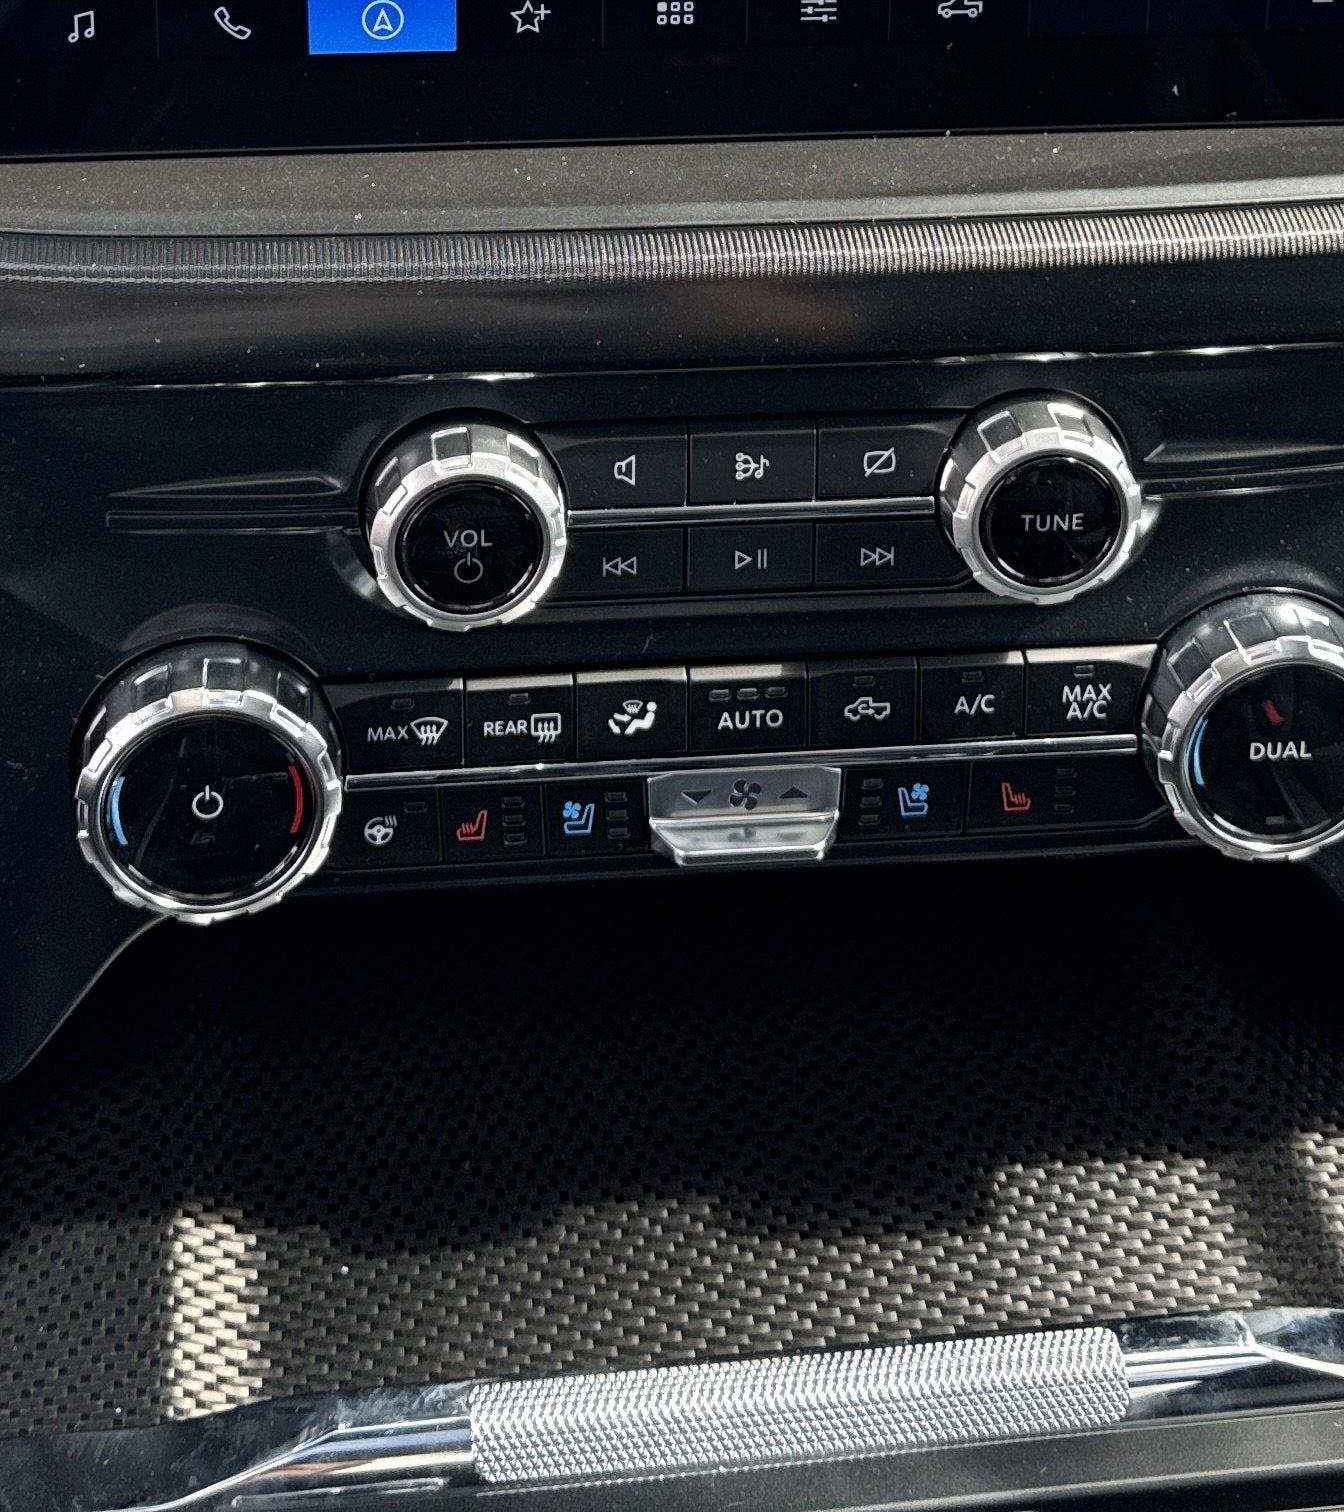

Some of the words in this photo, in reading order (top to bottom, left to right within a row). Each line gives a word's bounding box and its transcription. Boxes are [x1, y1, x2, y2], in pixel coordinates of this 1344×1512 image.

[1020, 512, 1085, 533] TUNE
[442, 528, 493, 549] VOL
[1062, 684, 1112, 703] MAX
[955, 693, 996, 716] A/C
[1066, 700, 1108, 721] A/C
[483, 719, 528, 738] REAR
[717, 709, 784, 731] AUTO
[367, 725, 409, 743] MAX
[1249, 741, 1313, 761] DUAL
